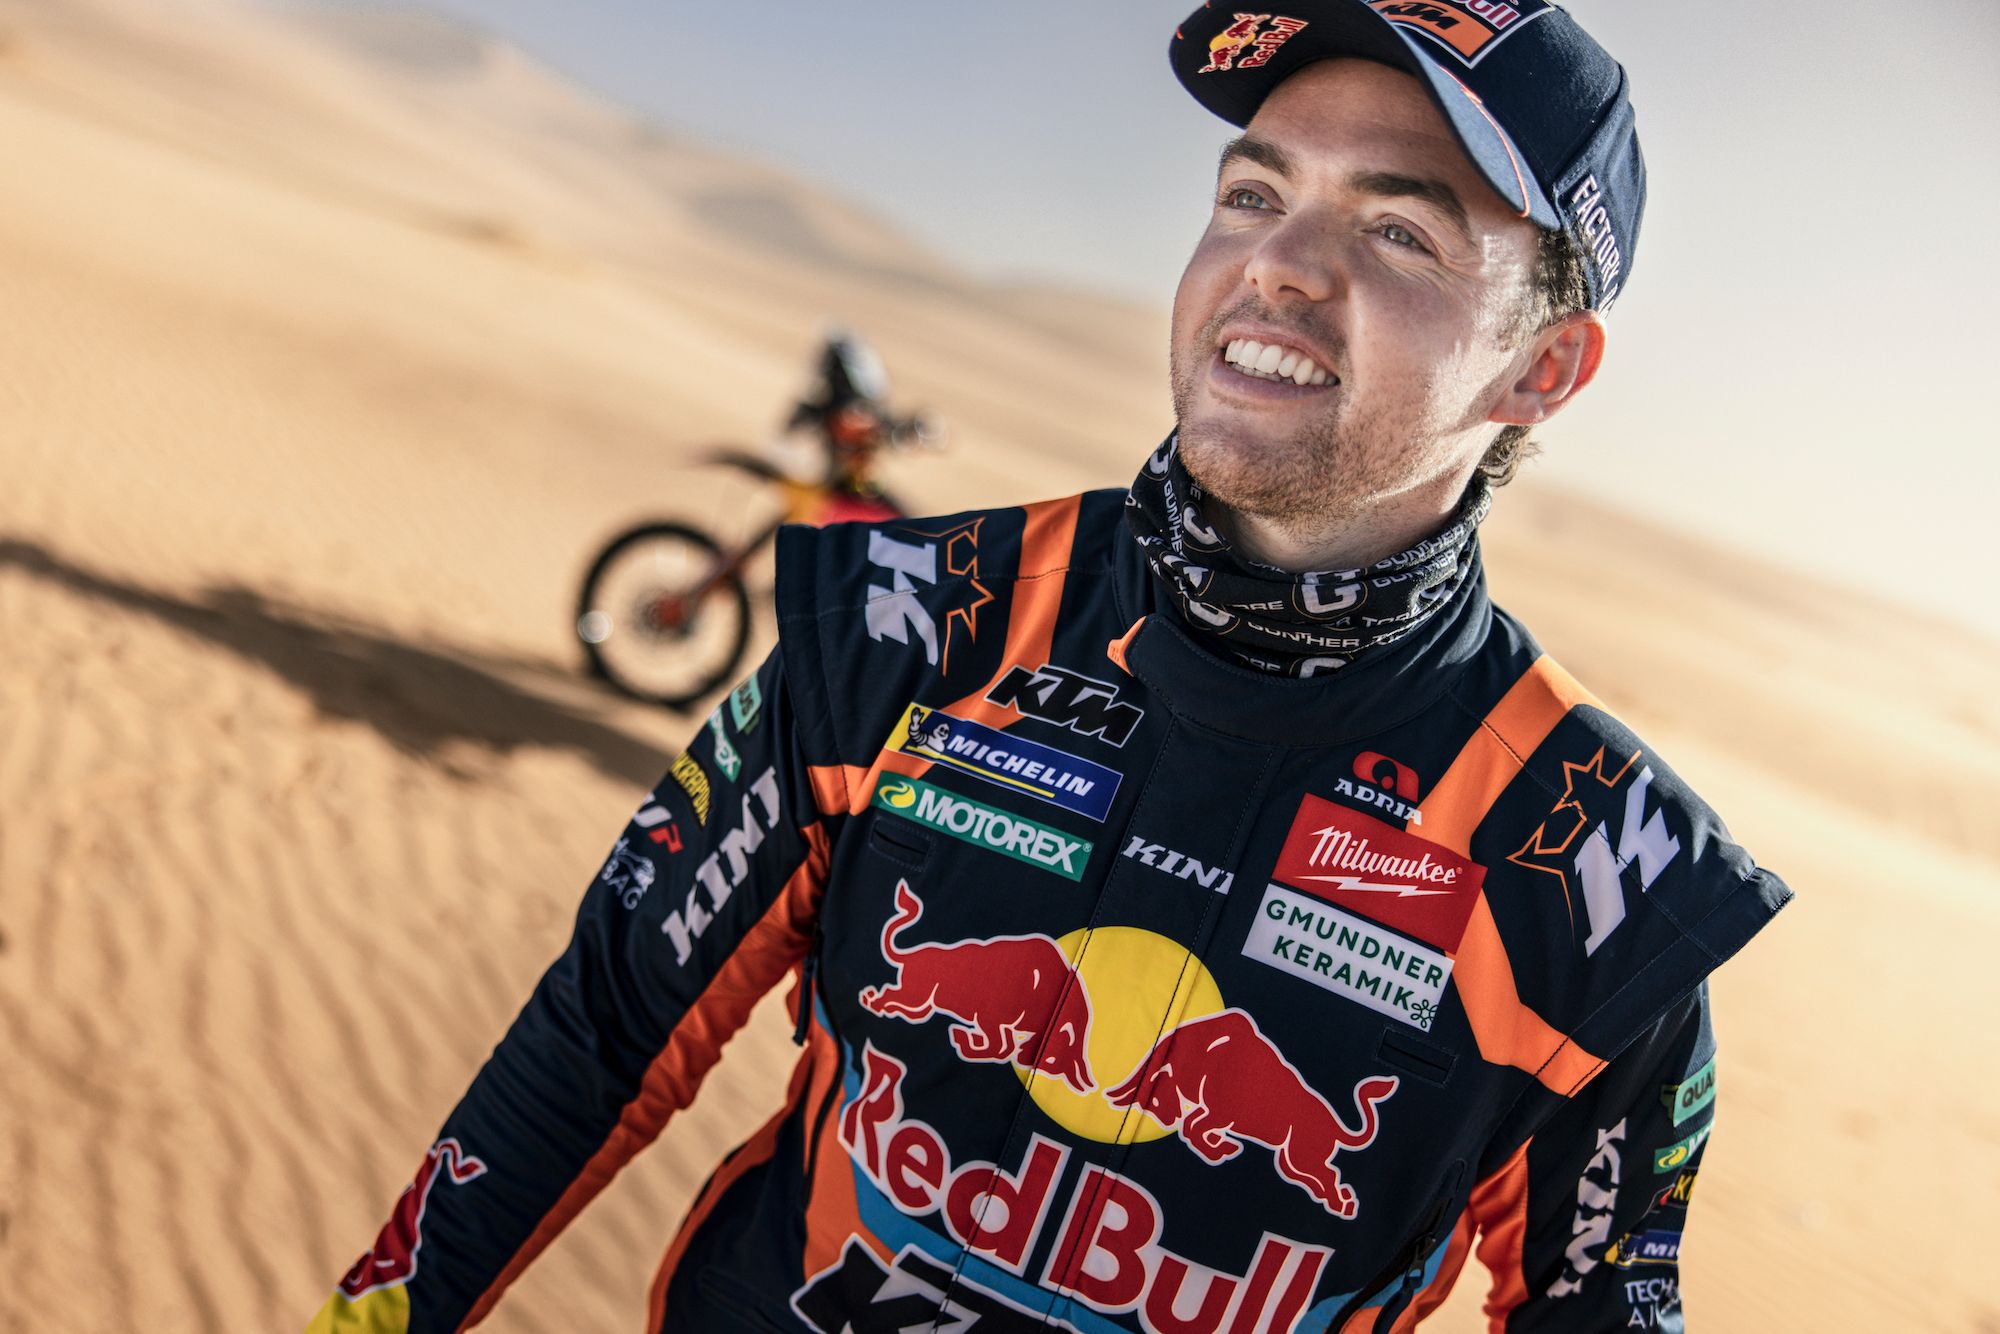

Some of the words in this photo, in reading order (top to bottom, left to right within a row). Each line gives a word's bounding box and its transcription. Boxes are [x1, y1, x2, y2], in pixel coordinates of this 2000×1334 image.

[1379, 4, 1460, 31] KTM
[1452, 0, 1521, 31] ull
[1571, 174, 1620, 293] FACTORY
[984, 663, 1145, 749] KTM
[947, 735, 1096, 797] MICHELIN
[1333, 778, 1423, 826] ADRIA
[660, 765, 781, 967] KINI
[1309, 825, 1457, 885] Milwaukee
[1265, 899, 1444, 989] GMUNDNER
[1272, 935, 1416, 1011] KERAMIK
[1681, 1064, 1715, 1109] QUA
[838, 1037, 1072, 1278] Red
[1038, 1161, 1335, 1334] Bull
